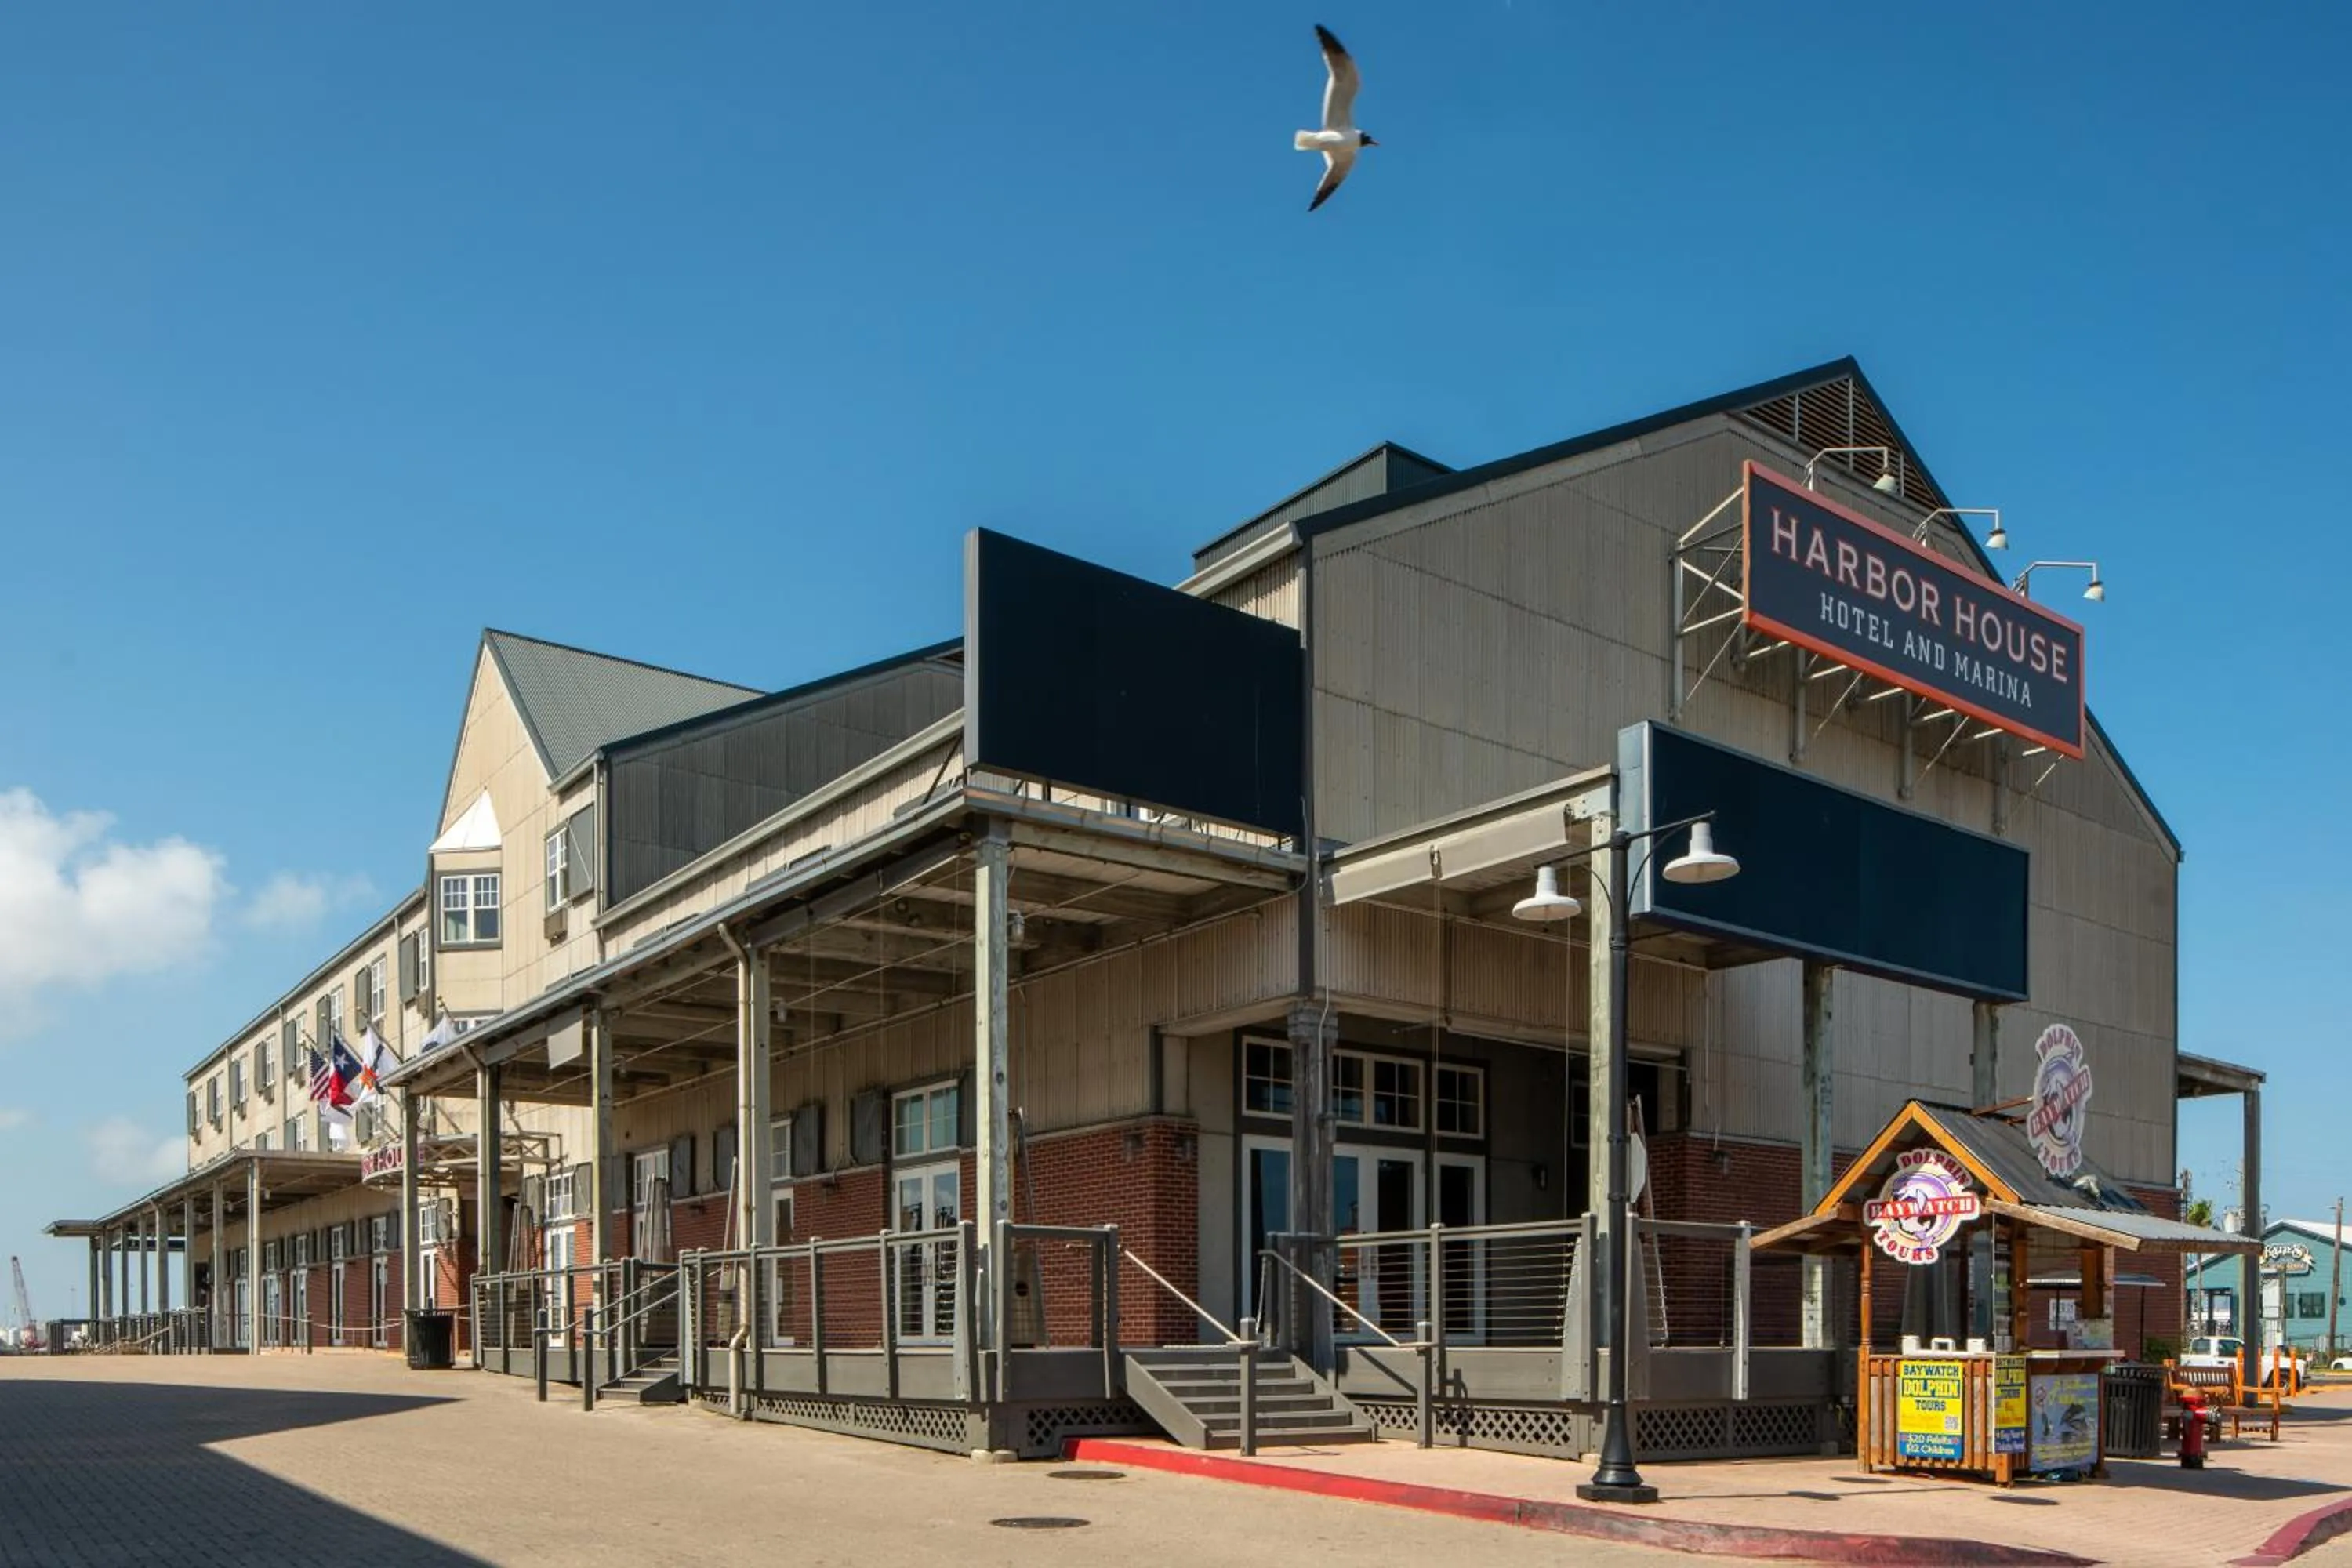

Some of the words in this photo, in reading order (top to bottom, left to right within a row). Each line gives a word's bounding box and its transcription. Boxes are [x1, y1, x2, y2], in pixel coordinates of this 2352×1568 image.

[1770, 506, 1941, 626] HARBOR
[1955, 593, 2068, 684] HOUSE
[1820, 592, 1894, 650] HOTEL
[1903, 630, 1946, 671] AND
[1954, 651, 2032, 709] MARINA
[377, 1145, 425, 1172] HOUE
[1900, 1150, 1971, 1185] DOLPHIN
[1871, 1196, 1973, 1218] BAYWATCH
[1877, 1229, 1936, 1261] TOURS
[1903, 1364, 1959, 1377] BAYWATCH
[1903, 1379, 1958, 1397] DOLPHIN
[1915, 1399, 1946, 1411] TOURS
